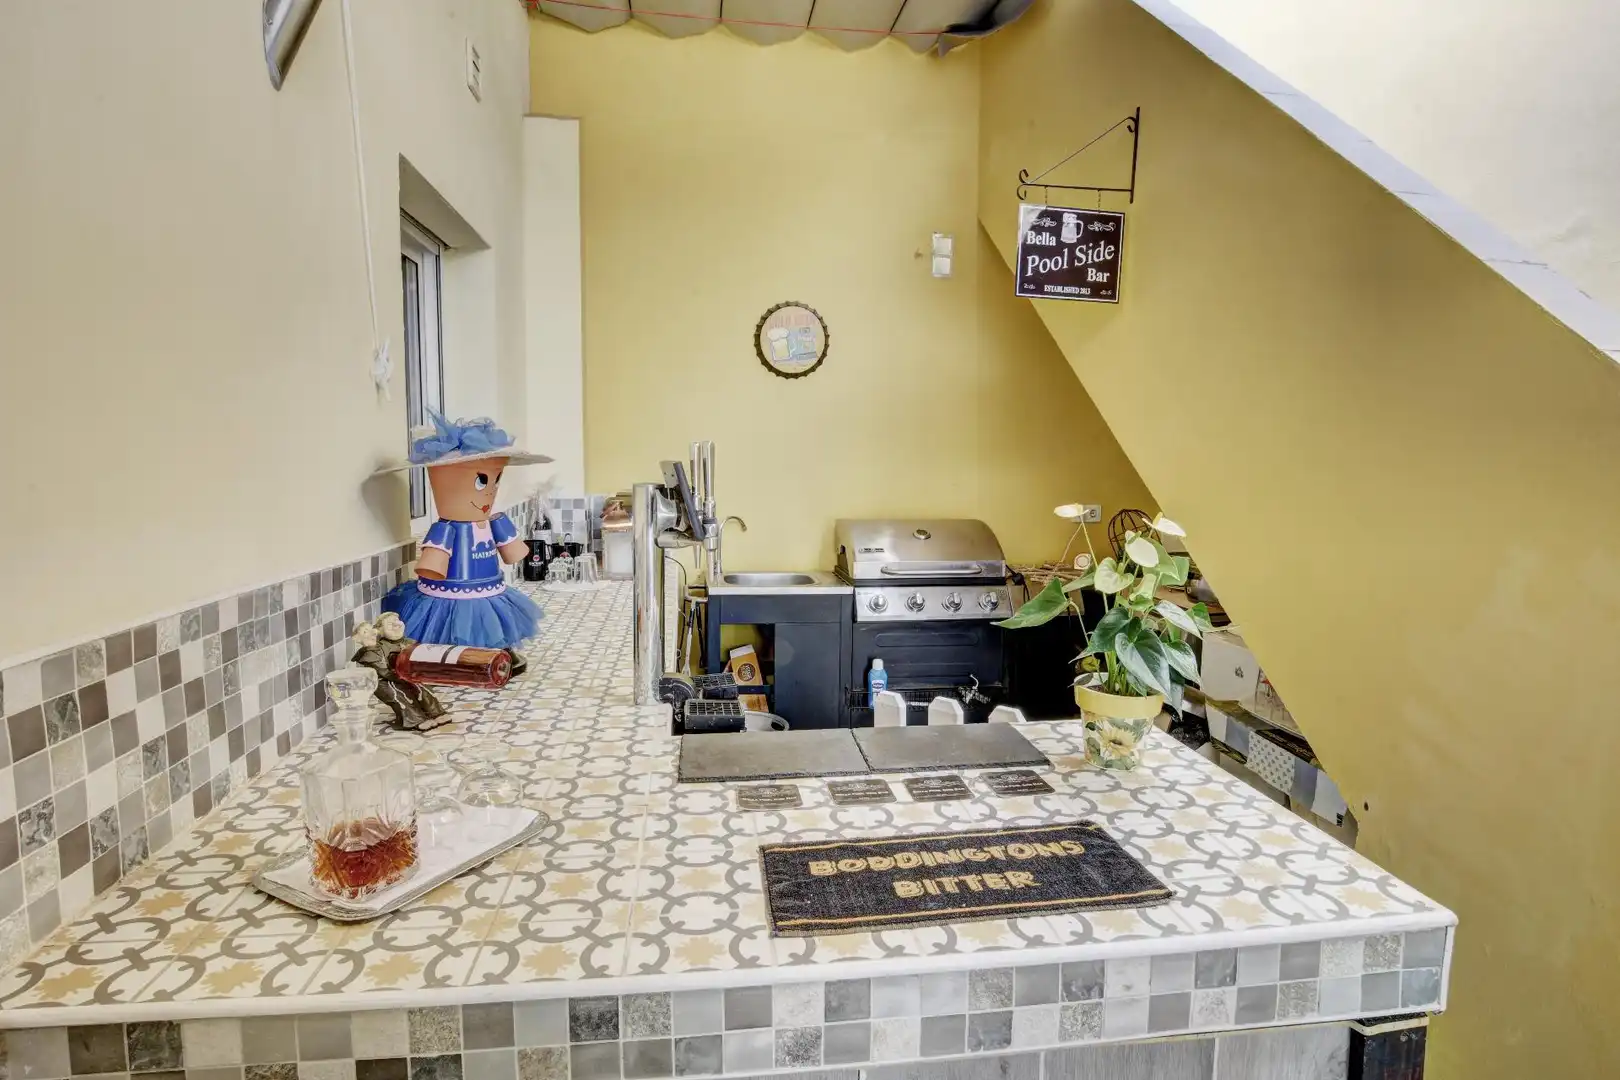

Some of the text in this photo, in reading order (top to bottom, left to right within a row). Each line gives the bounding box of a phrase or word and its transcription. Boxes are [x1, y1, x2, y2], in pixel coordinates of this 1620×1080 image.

[1026, 230, 1057, 246] Bella
[1025, 240, 1115, 277] Pool Side
[1086, 267, 1110, 283] Bar
[1044, 284, 1080, 294] ESTABLISHED
[808, 840, 1086, 876] BODDINGTONS
[893, 871, 1043, 898] BITTER
